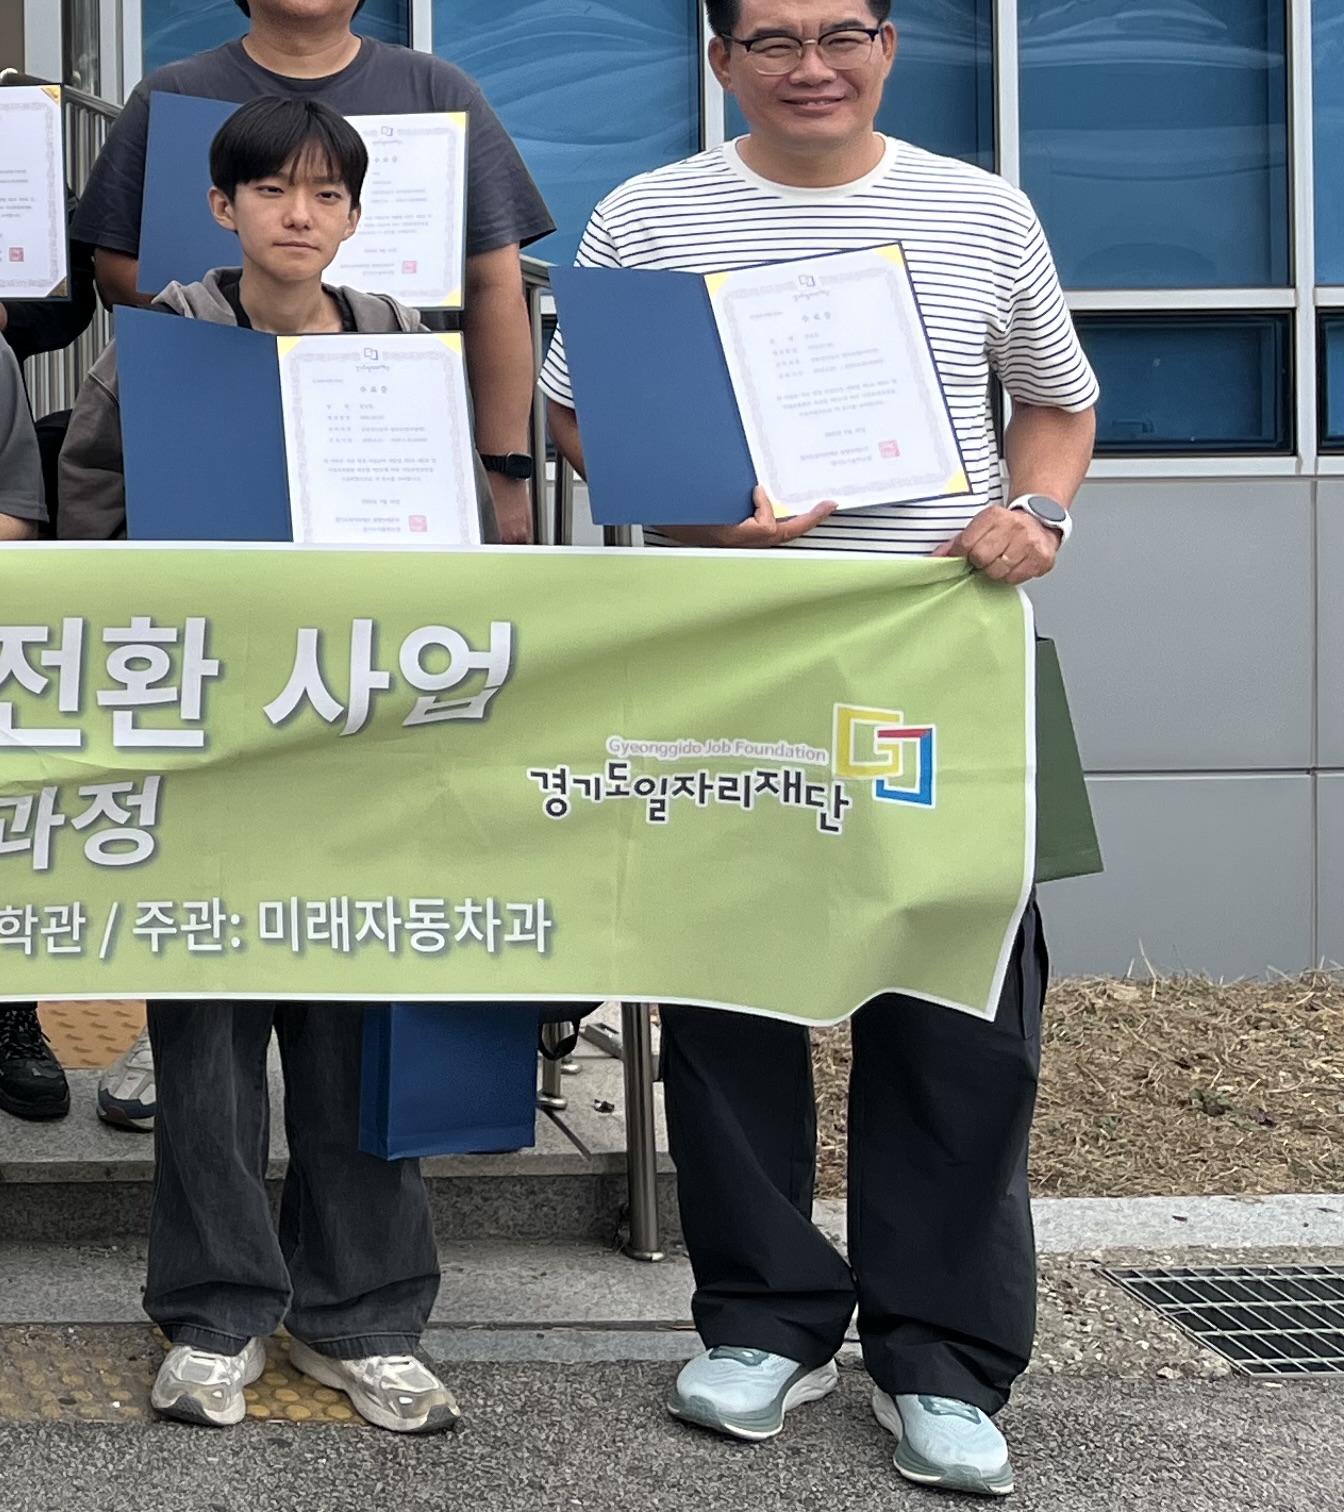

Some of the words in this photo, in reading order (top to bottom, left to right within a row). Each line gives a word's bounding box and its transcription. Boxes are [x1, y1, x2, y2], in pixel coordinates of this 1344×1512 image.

[263, 618, 513, 737] 사업
[608, 738, 702, 759] Gyeonggido
[704, 739, 732, 756] Job
[734, 741, 827, 763] Foundation
[529, 761, 851, 833] 경기도일자리재단
[132, 898, 242, 953] 주관:
[258, 895, 552, 954] 미래자동차과
